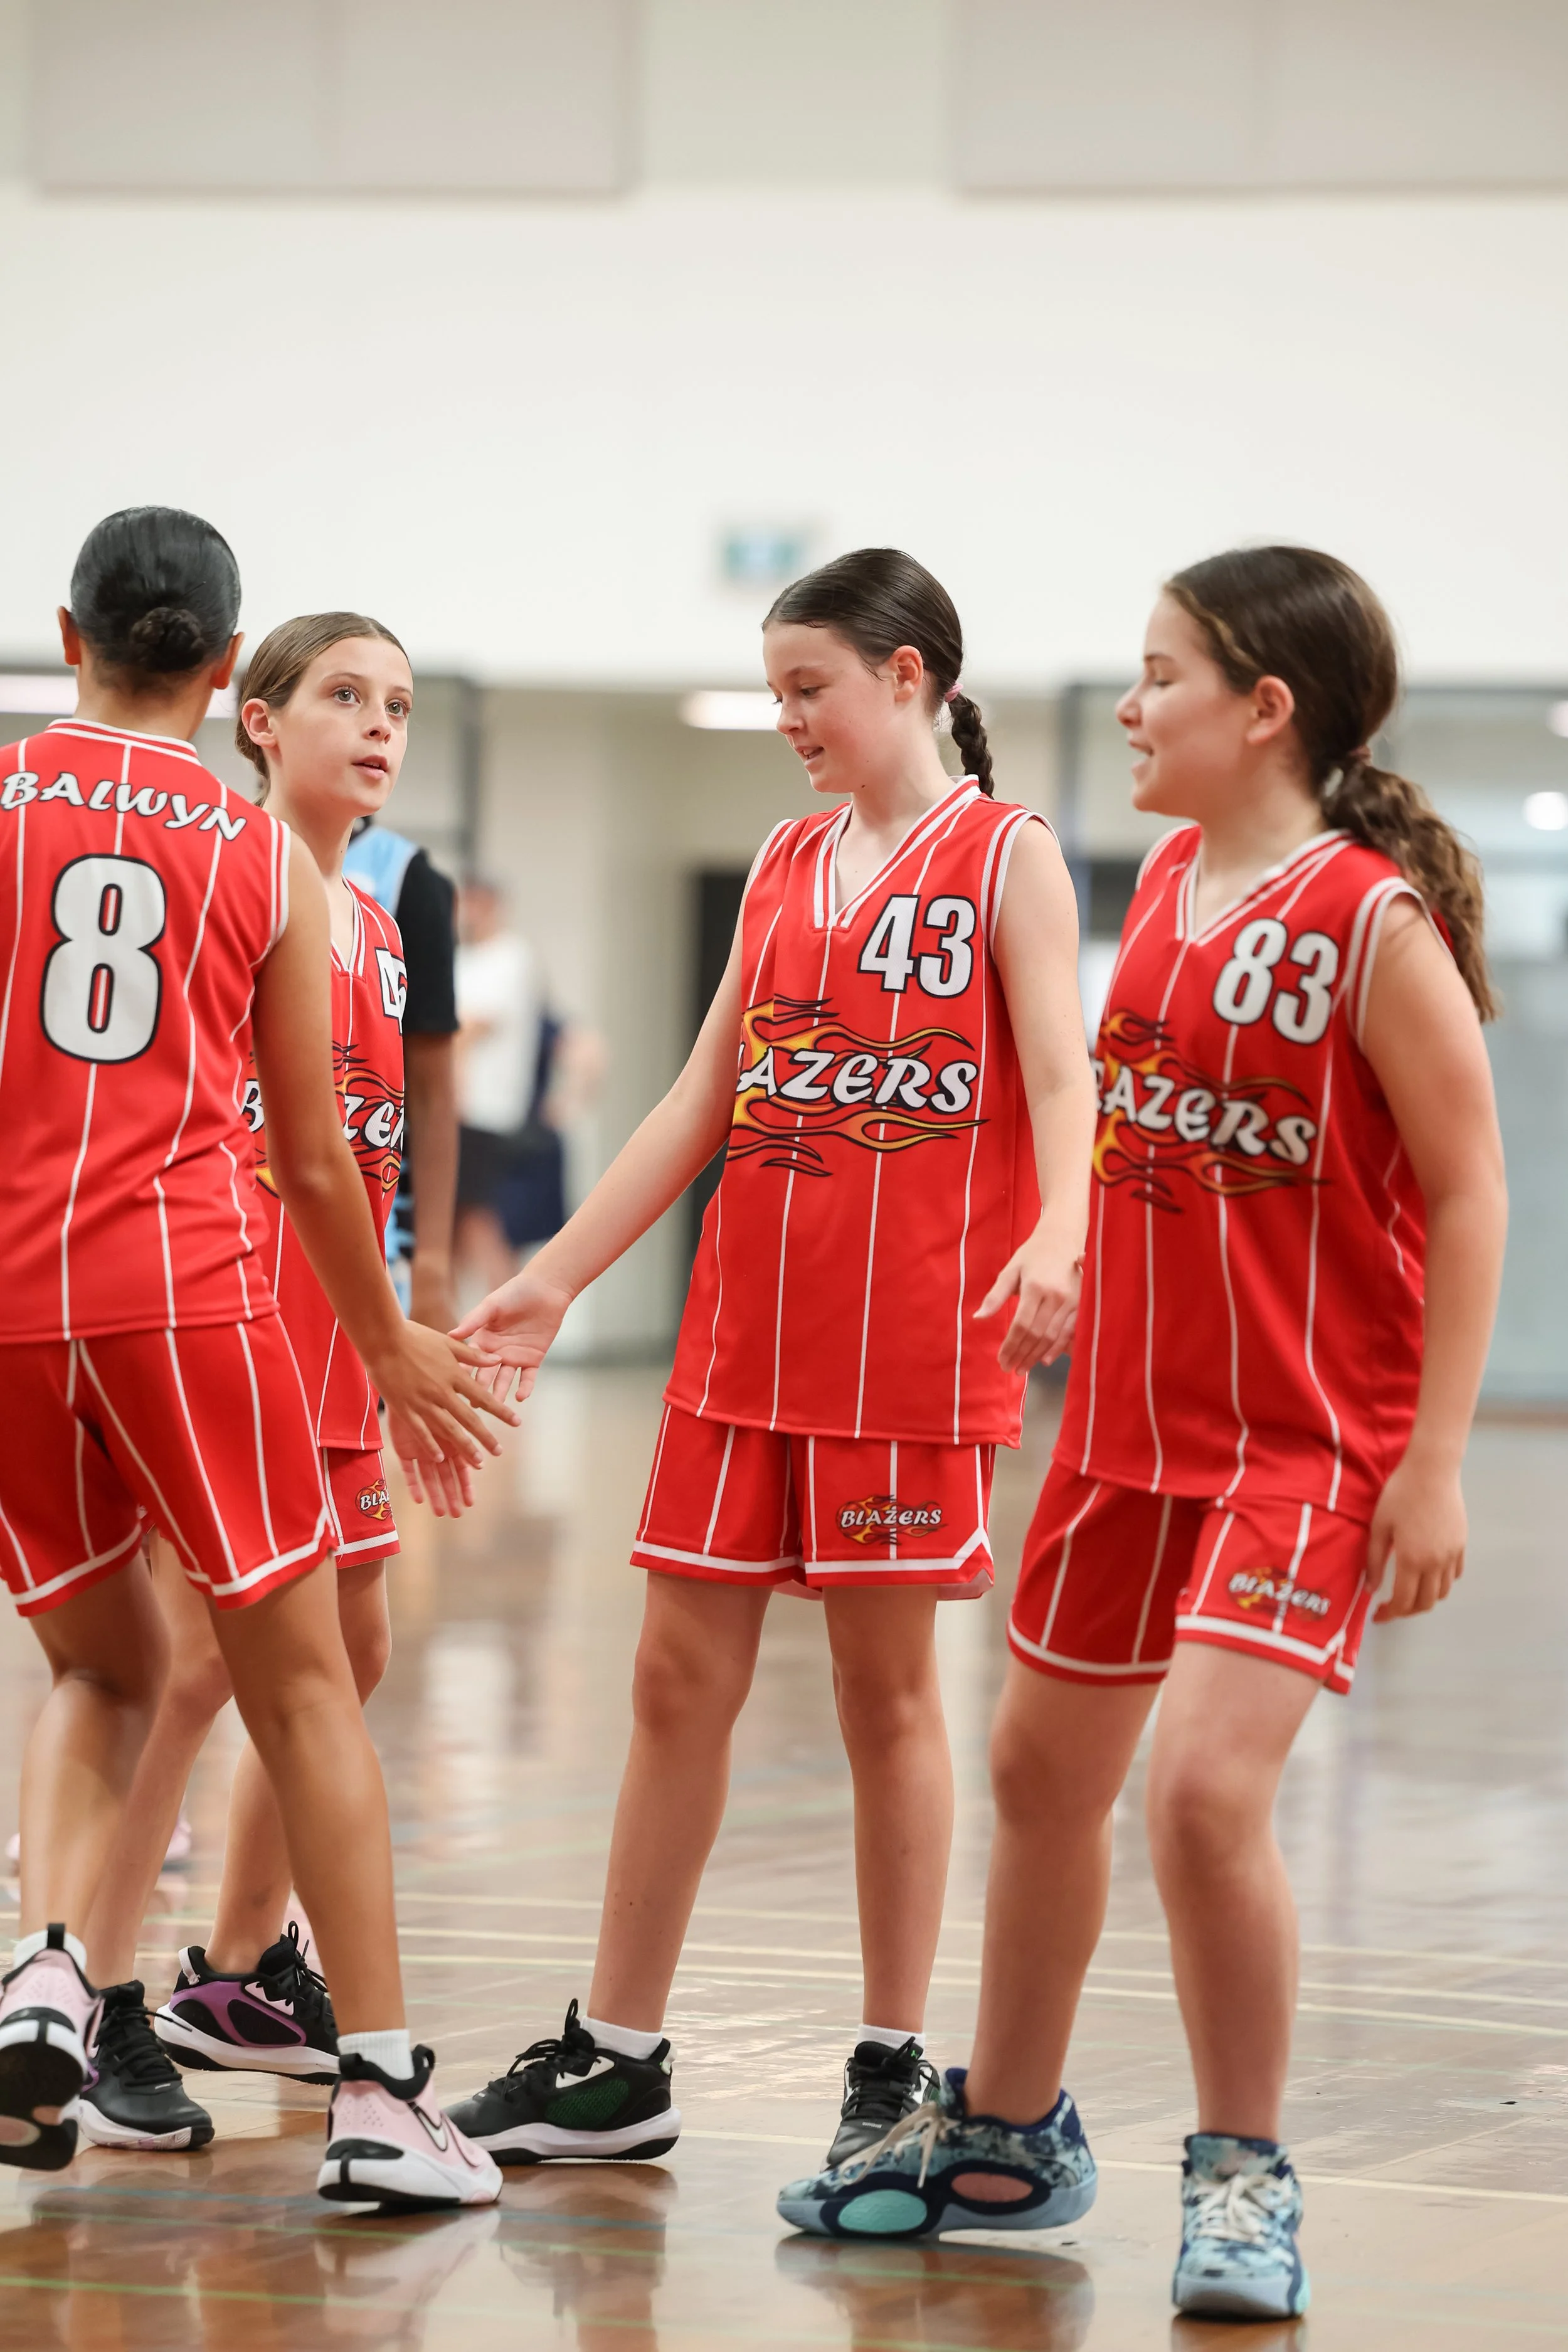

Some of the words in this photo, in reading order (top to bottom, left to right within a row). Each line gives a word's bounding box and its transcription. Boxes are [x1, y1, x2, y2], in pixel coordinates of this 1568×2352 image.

[1, 771, 246, 841] BALWYN
[40, 853, 166, 1065] 8
[857, 894, 977, 999] 43
[1213, 918, 1339, 1045] 83
[736, 1044, 977, 1114] AZERS
[360, 1490, 389, 1510] BLA
[840, 1508, 943, 1528] BLAZERS
